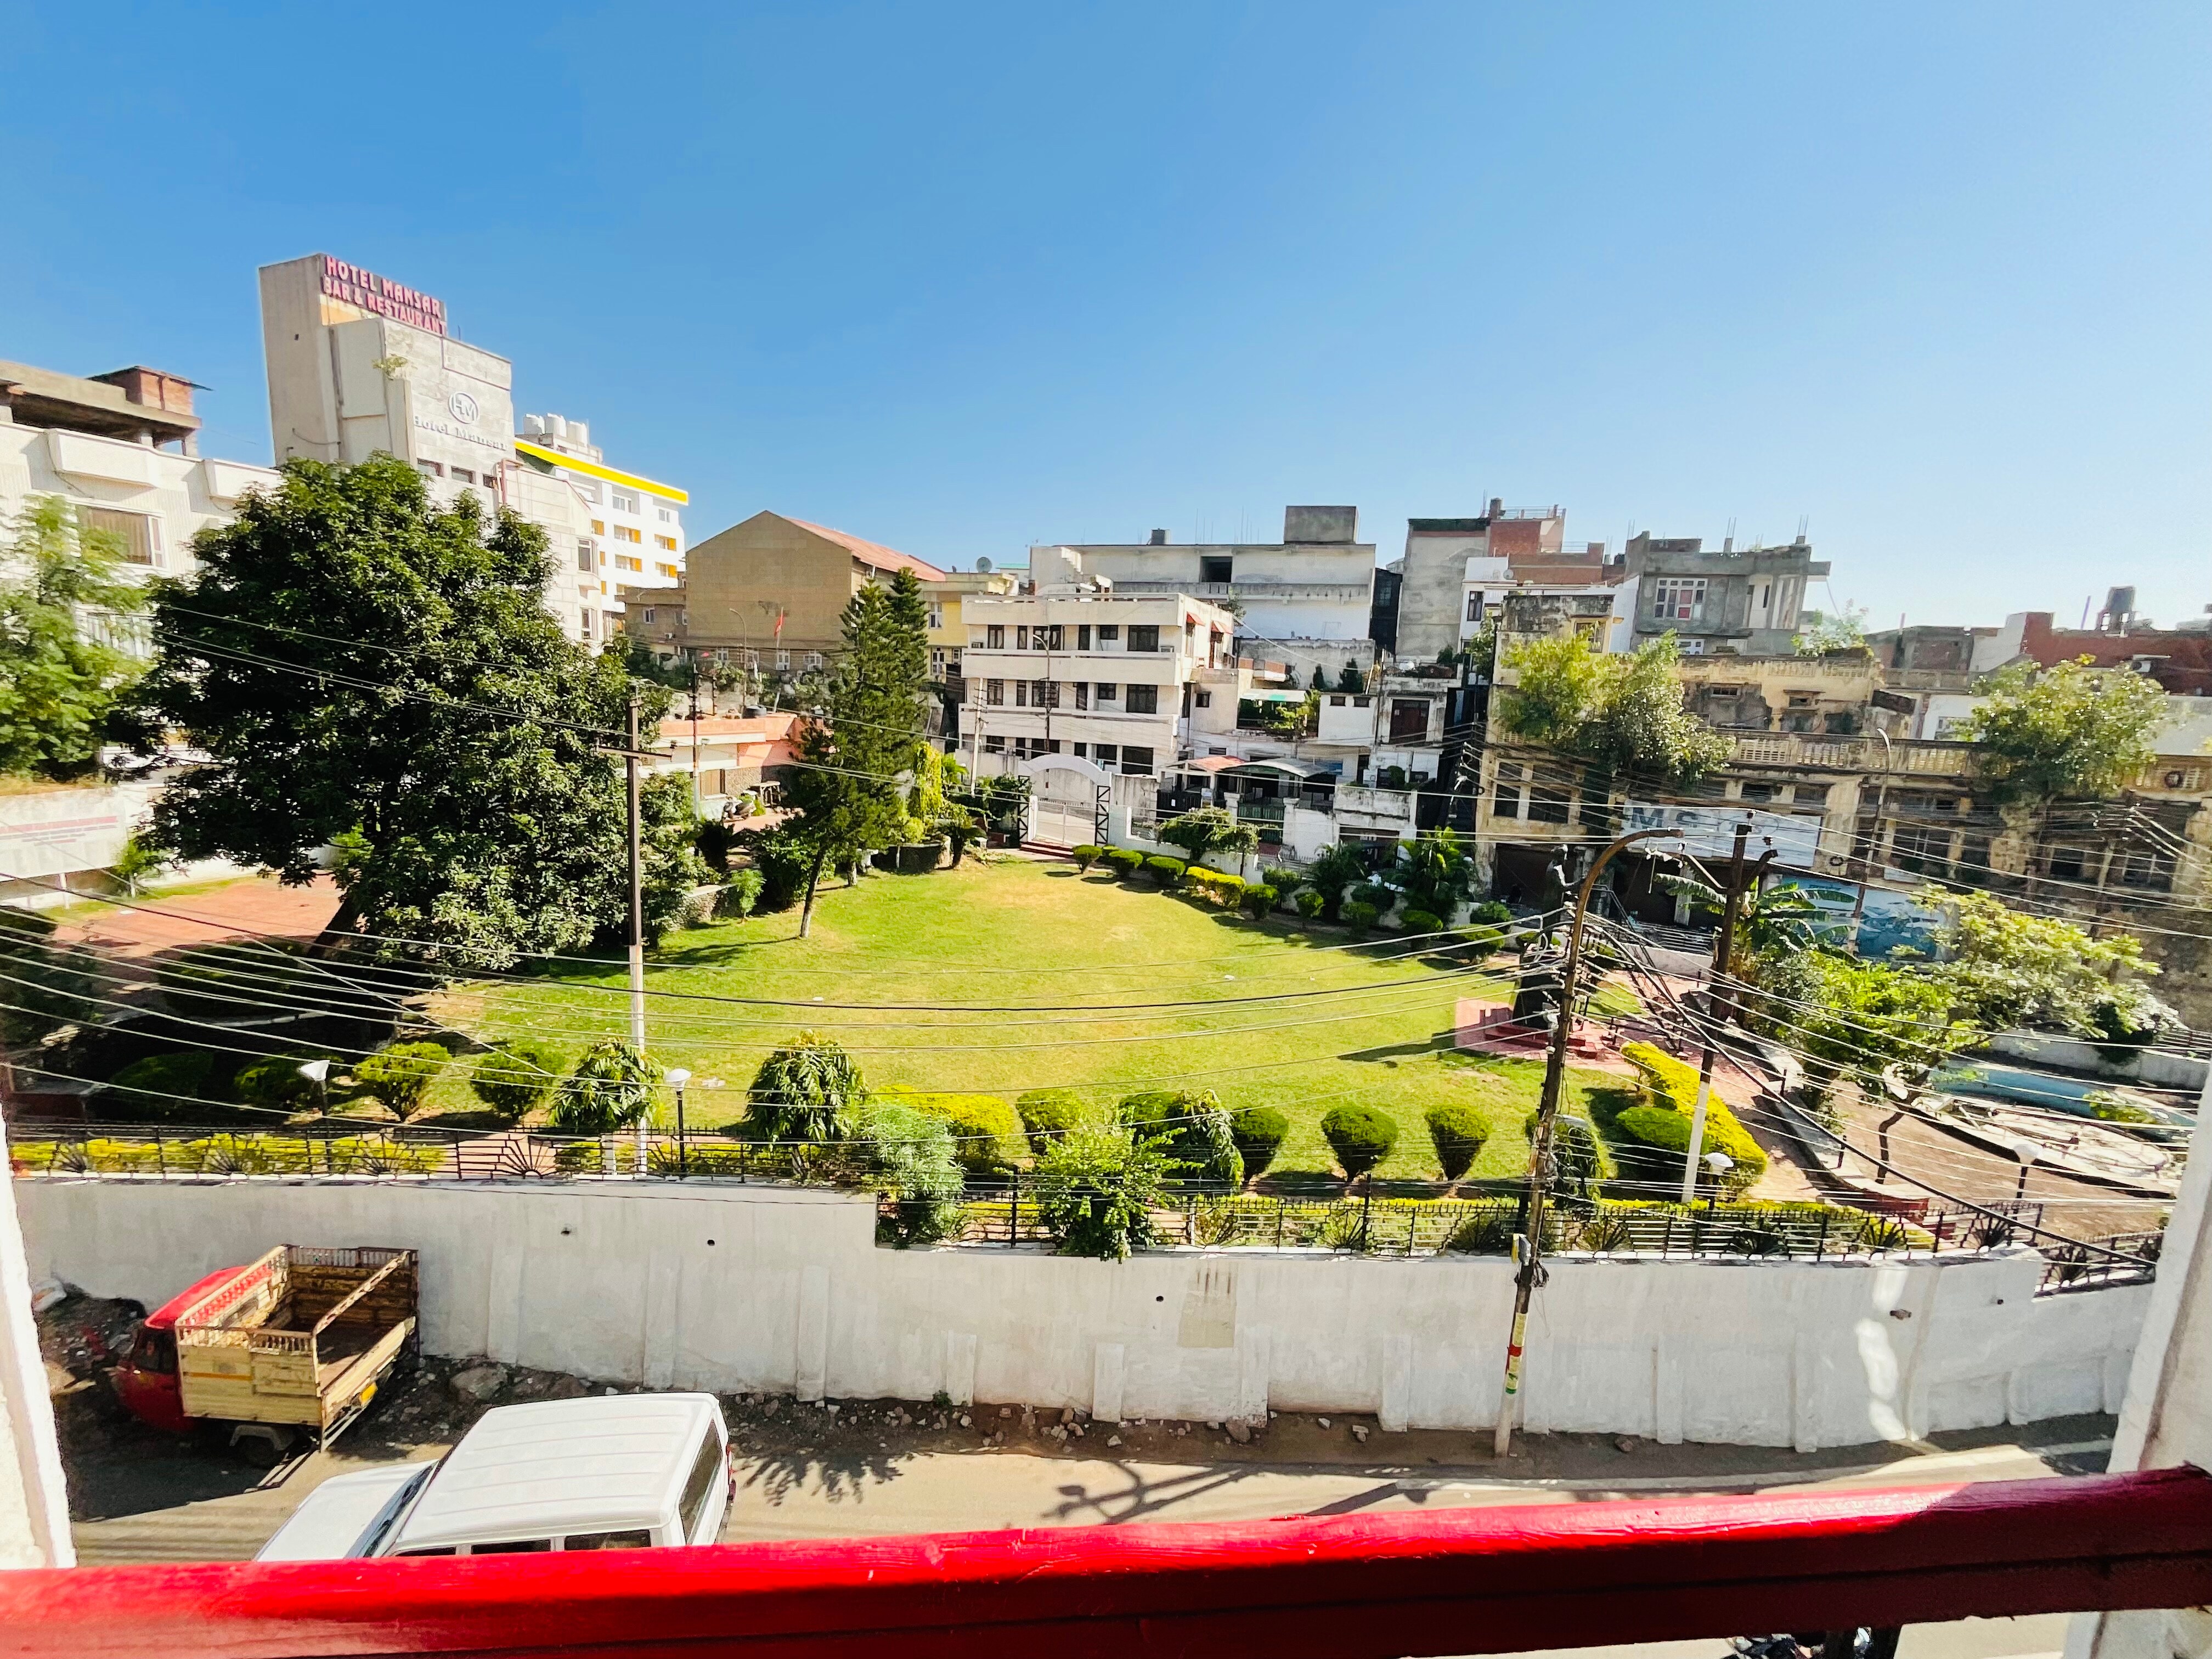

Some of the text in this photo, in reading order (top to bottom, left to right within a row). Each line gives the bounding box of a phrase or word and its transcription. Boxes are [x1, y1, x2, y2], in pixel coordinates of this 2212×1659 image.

[323, 275, 447, 336] BAR & RESTAURANT
[326, 255, 441, 318] HOTEL MANSAR
